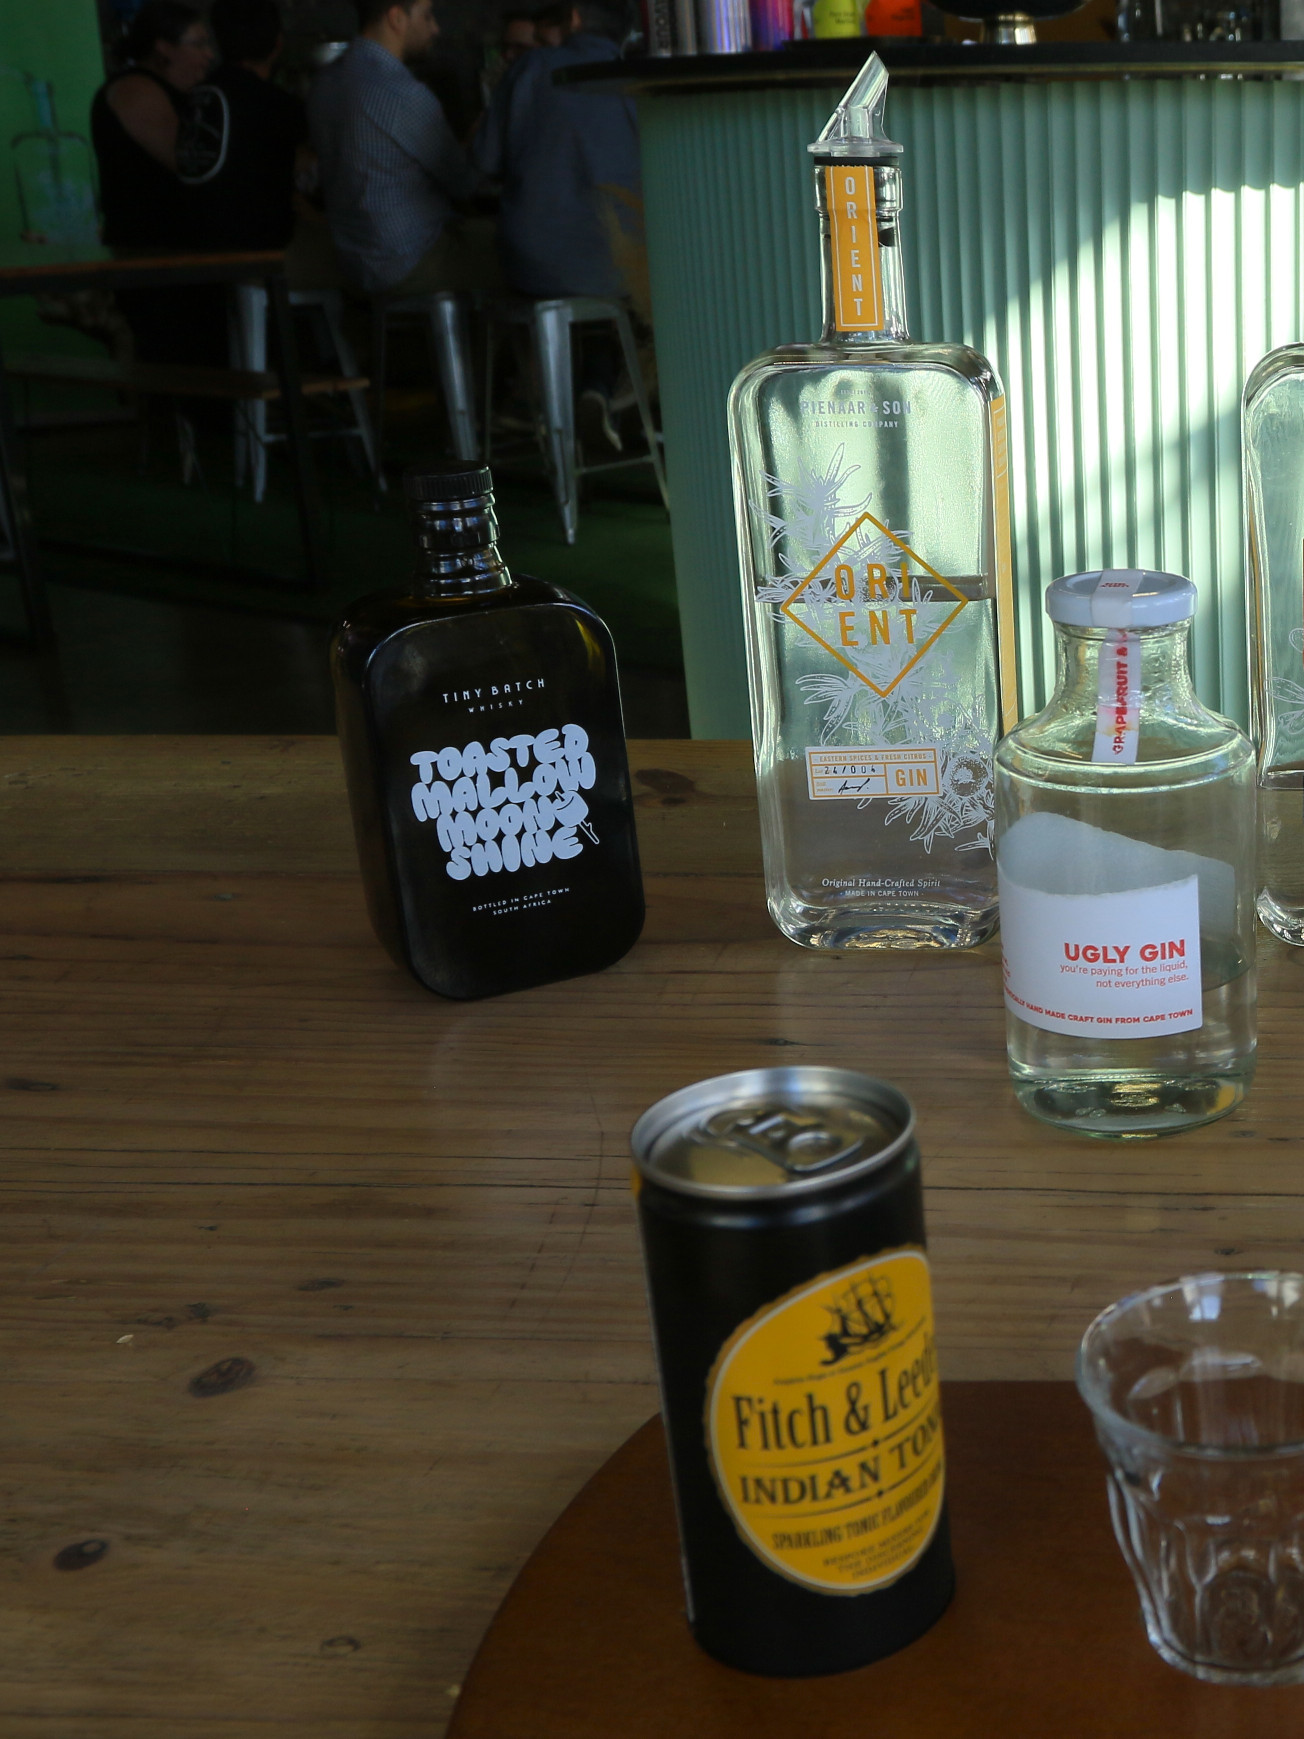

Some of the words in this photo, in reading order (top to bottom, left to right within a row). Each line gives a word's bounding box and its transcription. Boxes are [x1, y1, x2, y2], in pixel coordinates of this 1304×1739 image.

[844, 176, 863, 316] ORIENT
[800, 400, 866, 415] PIENAAR
[882, 400, 911, 415] SON
[815, 420, 859, 428] DISTILLING
[834, 561, 910, 601] ORI
[838, 609, 917, 647] ENT
[442, 688, 482, 703] TINY
[491, 678, 545, 696] BATCH
[468, 699, 524, 713] WHISKY
[410, 723, 589, 785] TOASTED
[411, 751, 596, 822] MALLOW
[895, 768, 928, 787] GIN
[436, 795, 556, 853] MOON
[446, 826, 583, 881] SHINE
[821, 878, 855, 888] Original
[858, 878, 915, 888] Hand-Crafted
[917, 878, 940, 888] Spirit
[472, 899, 507, 911] BOTTLED
[523, 892, 543, 901] CAPE
[547, 887, 570, 896] TOWN
[493, 905, 519, 915] SOUTH
[522, 899, 551, 909] AFRICA
[1063, 942, 1131, 964] UGLY
[1139, 939, 1186, 962] GIN
[1059, 963, 1088, 975] you're
[1091, 966, 1123, 977] paying
[1125, 964, 1139, 975] for
[1141, 964, 1157, 974] the
[1159, 960, 1188, 973] liquid,
[1096, 979, 1112, 988] not
[1114, 976, 1166, 989] everything
[1168, 972, 1189, 983] else.
[1025, 1002, 1043, 1013] HAND
[1044, 1008, 1066, 1019] MADE
[1067, 1013, 1094, 1023] CRAFT
[1096, 1016, 1113, 1024] GIN
[1115, 1016, 1140, 1024] FROM
[1142, 1014, 1166, 1023] CAPE
[1168, 1008, 1193, 1020] TOWN
[730, 1390, 832, 1451] Fitch
[843, 1380, 870, 1436] &
[878, 1331, 934, 1422] Leed
[737, 1452, 881, 1507] INDIAN
[770, 1526, 842, 1551] SPARKLING
[845, 1512, 880, 1540] TONIC
